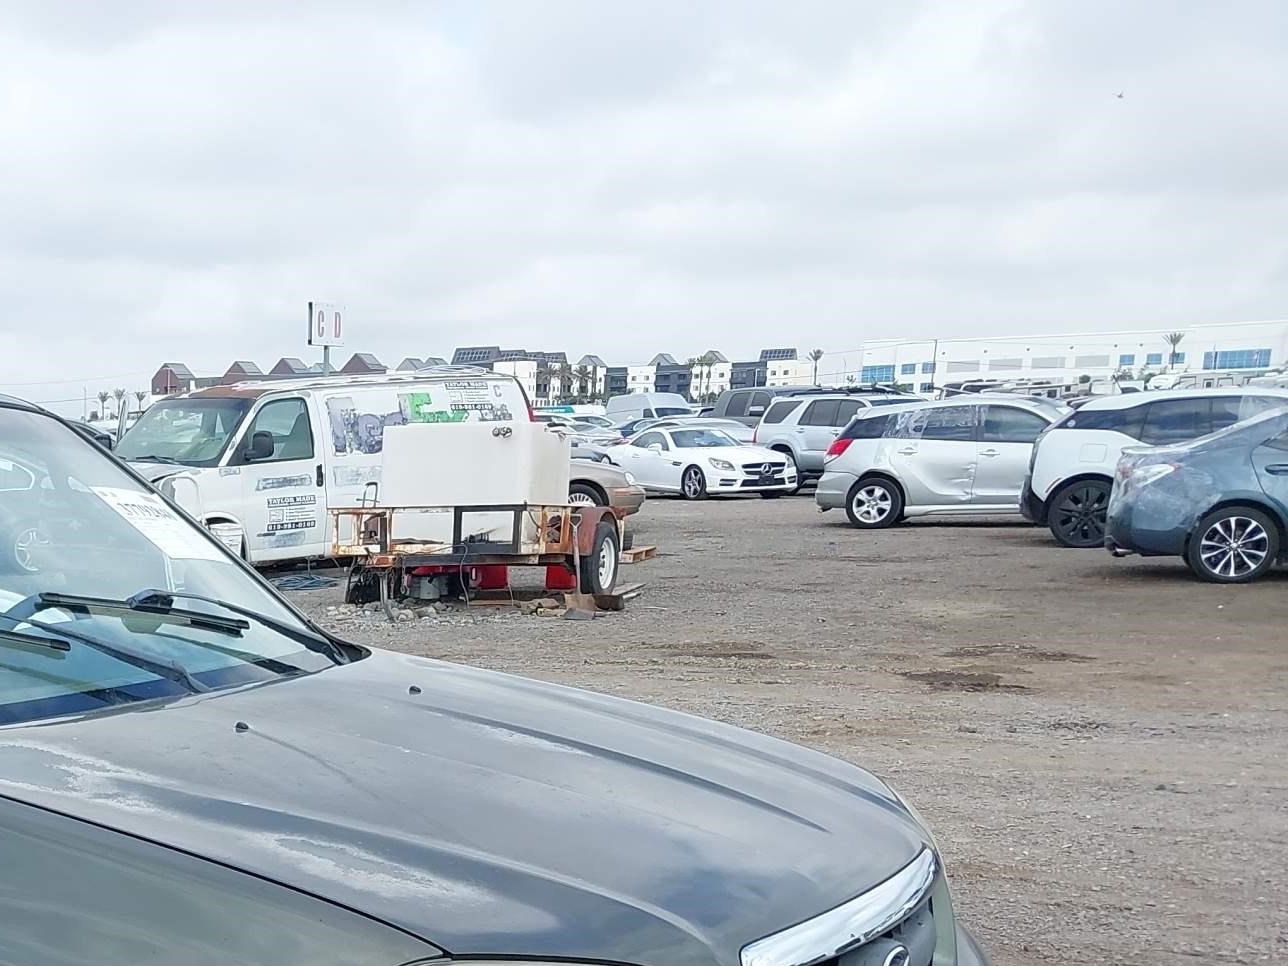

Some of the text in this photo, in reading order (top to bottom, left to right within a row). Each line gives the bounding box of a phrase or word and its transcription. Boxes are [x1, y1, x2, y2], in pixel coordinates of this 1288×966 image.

[317, 310, 342, 339] C D
[268, 497, 295, 505] TAYLOR
